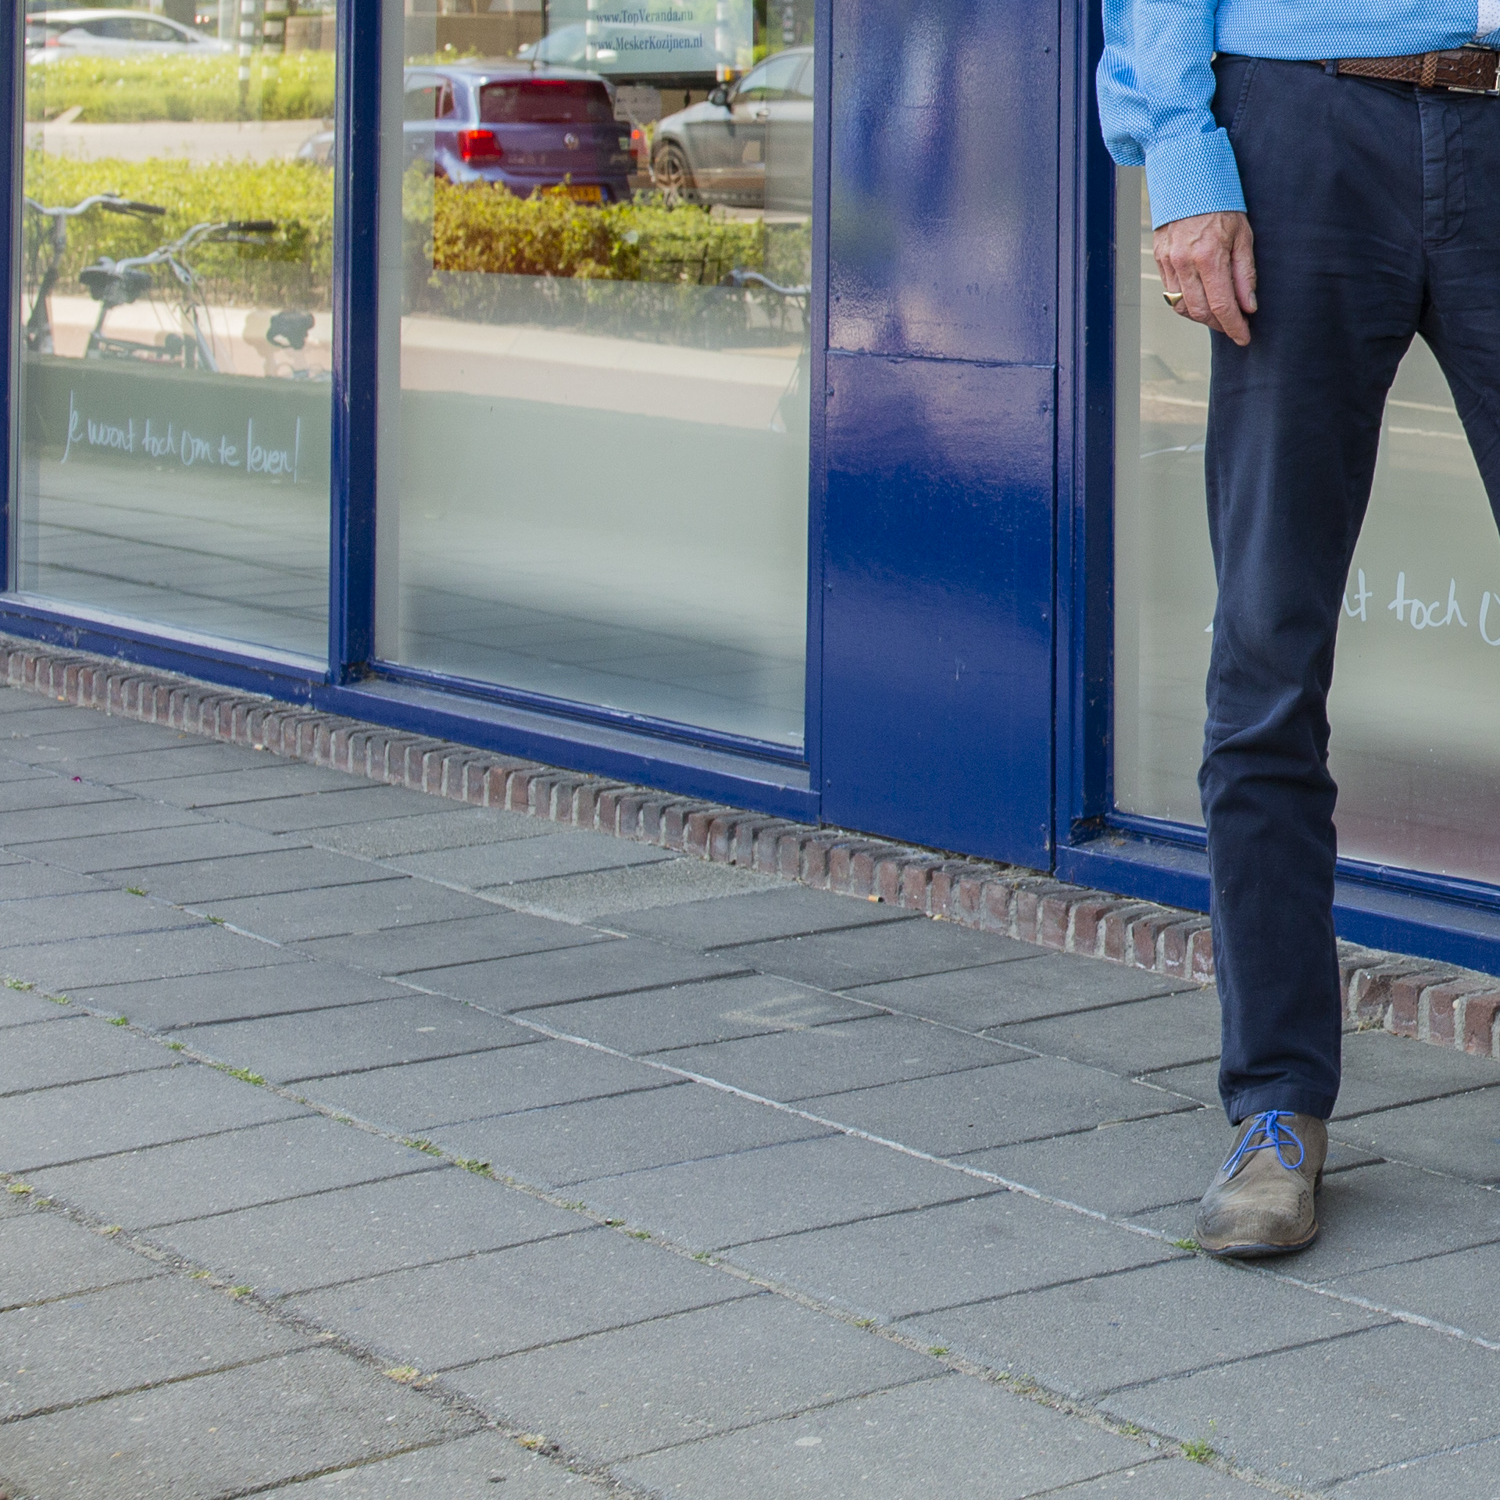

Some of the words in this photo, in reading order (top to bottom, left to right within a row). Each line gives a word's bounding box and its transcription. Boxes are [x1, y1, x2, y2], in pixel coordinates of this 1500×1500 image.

[596, 7, 694, 26] www.TopVeranda.nu
[87, 417, 135, 453] woont
[142, 418, 176, 457] toch
[218, 435, 240, 467] te
[246, 415, 301, 484] leven!
[1388, 570, 1468, 630] toch
